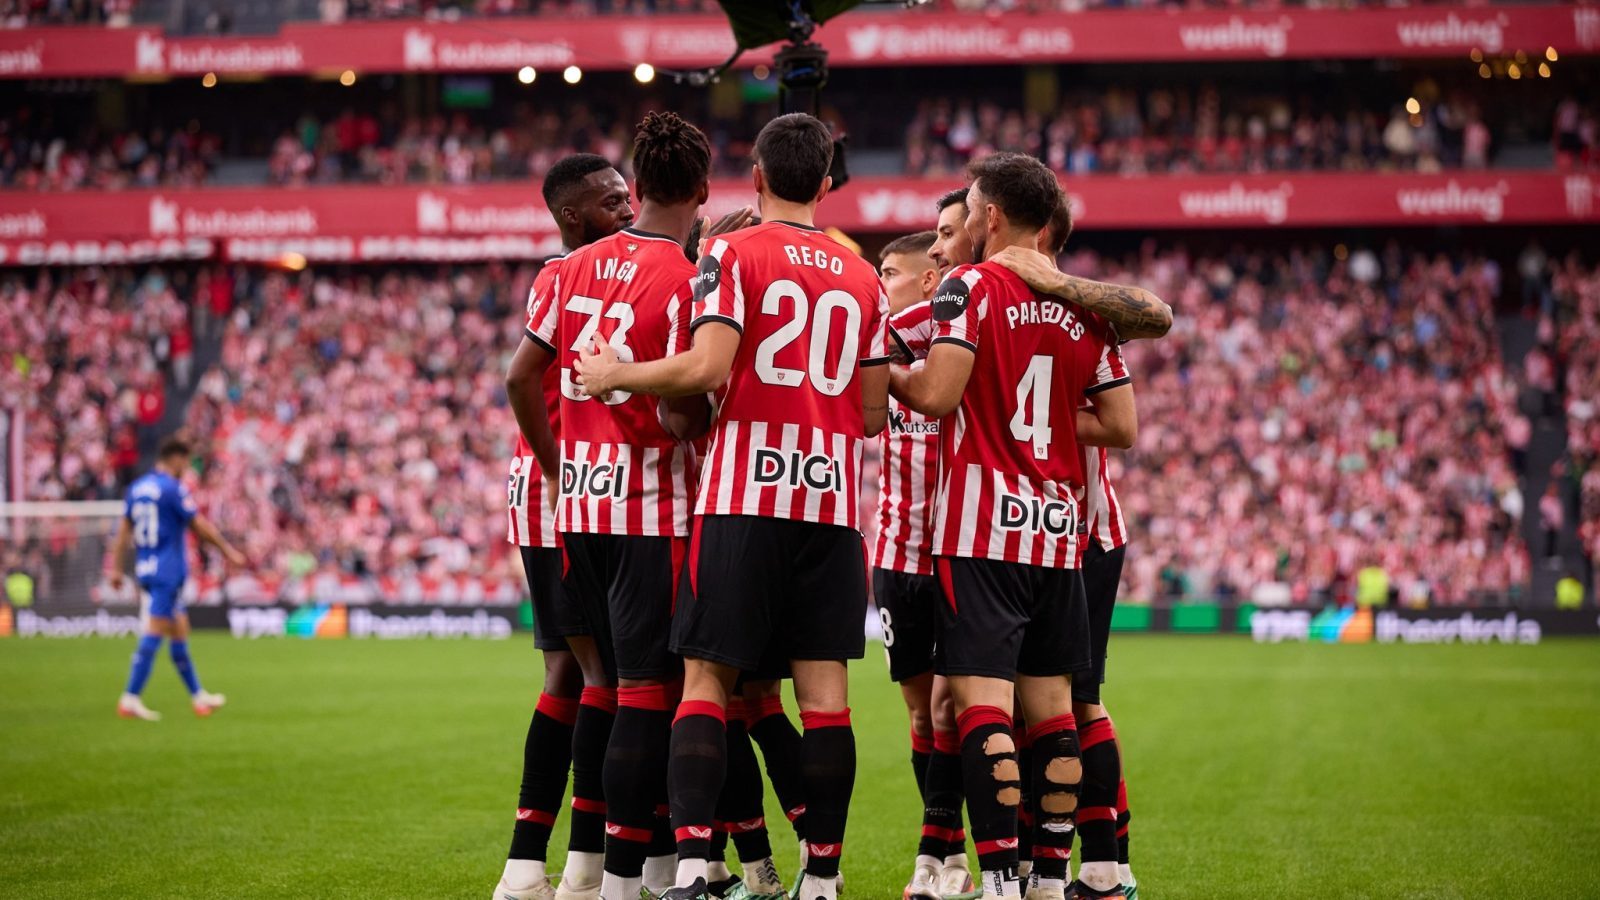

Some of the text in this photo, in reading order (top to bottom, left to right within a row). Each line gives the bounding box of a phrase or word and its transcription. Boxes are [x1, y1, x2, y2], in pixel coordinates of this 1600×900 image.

[595, 257, 638, 285] INGA
[784, 245, 845, 276] REGO
[754, 279, 863, 397] 20
[1005, 301, 1086, 342] PAREDES
[888, 407, 939, 434] Kutxa
[1009, 355, 1054, 460] 4
[561, 461, 625, 498] DIGI
[753, 448, 843, 493] DIGI
[1000, 494, 1076, 536] DIGI
[880, 607, 895, 648] 8
